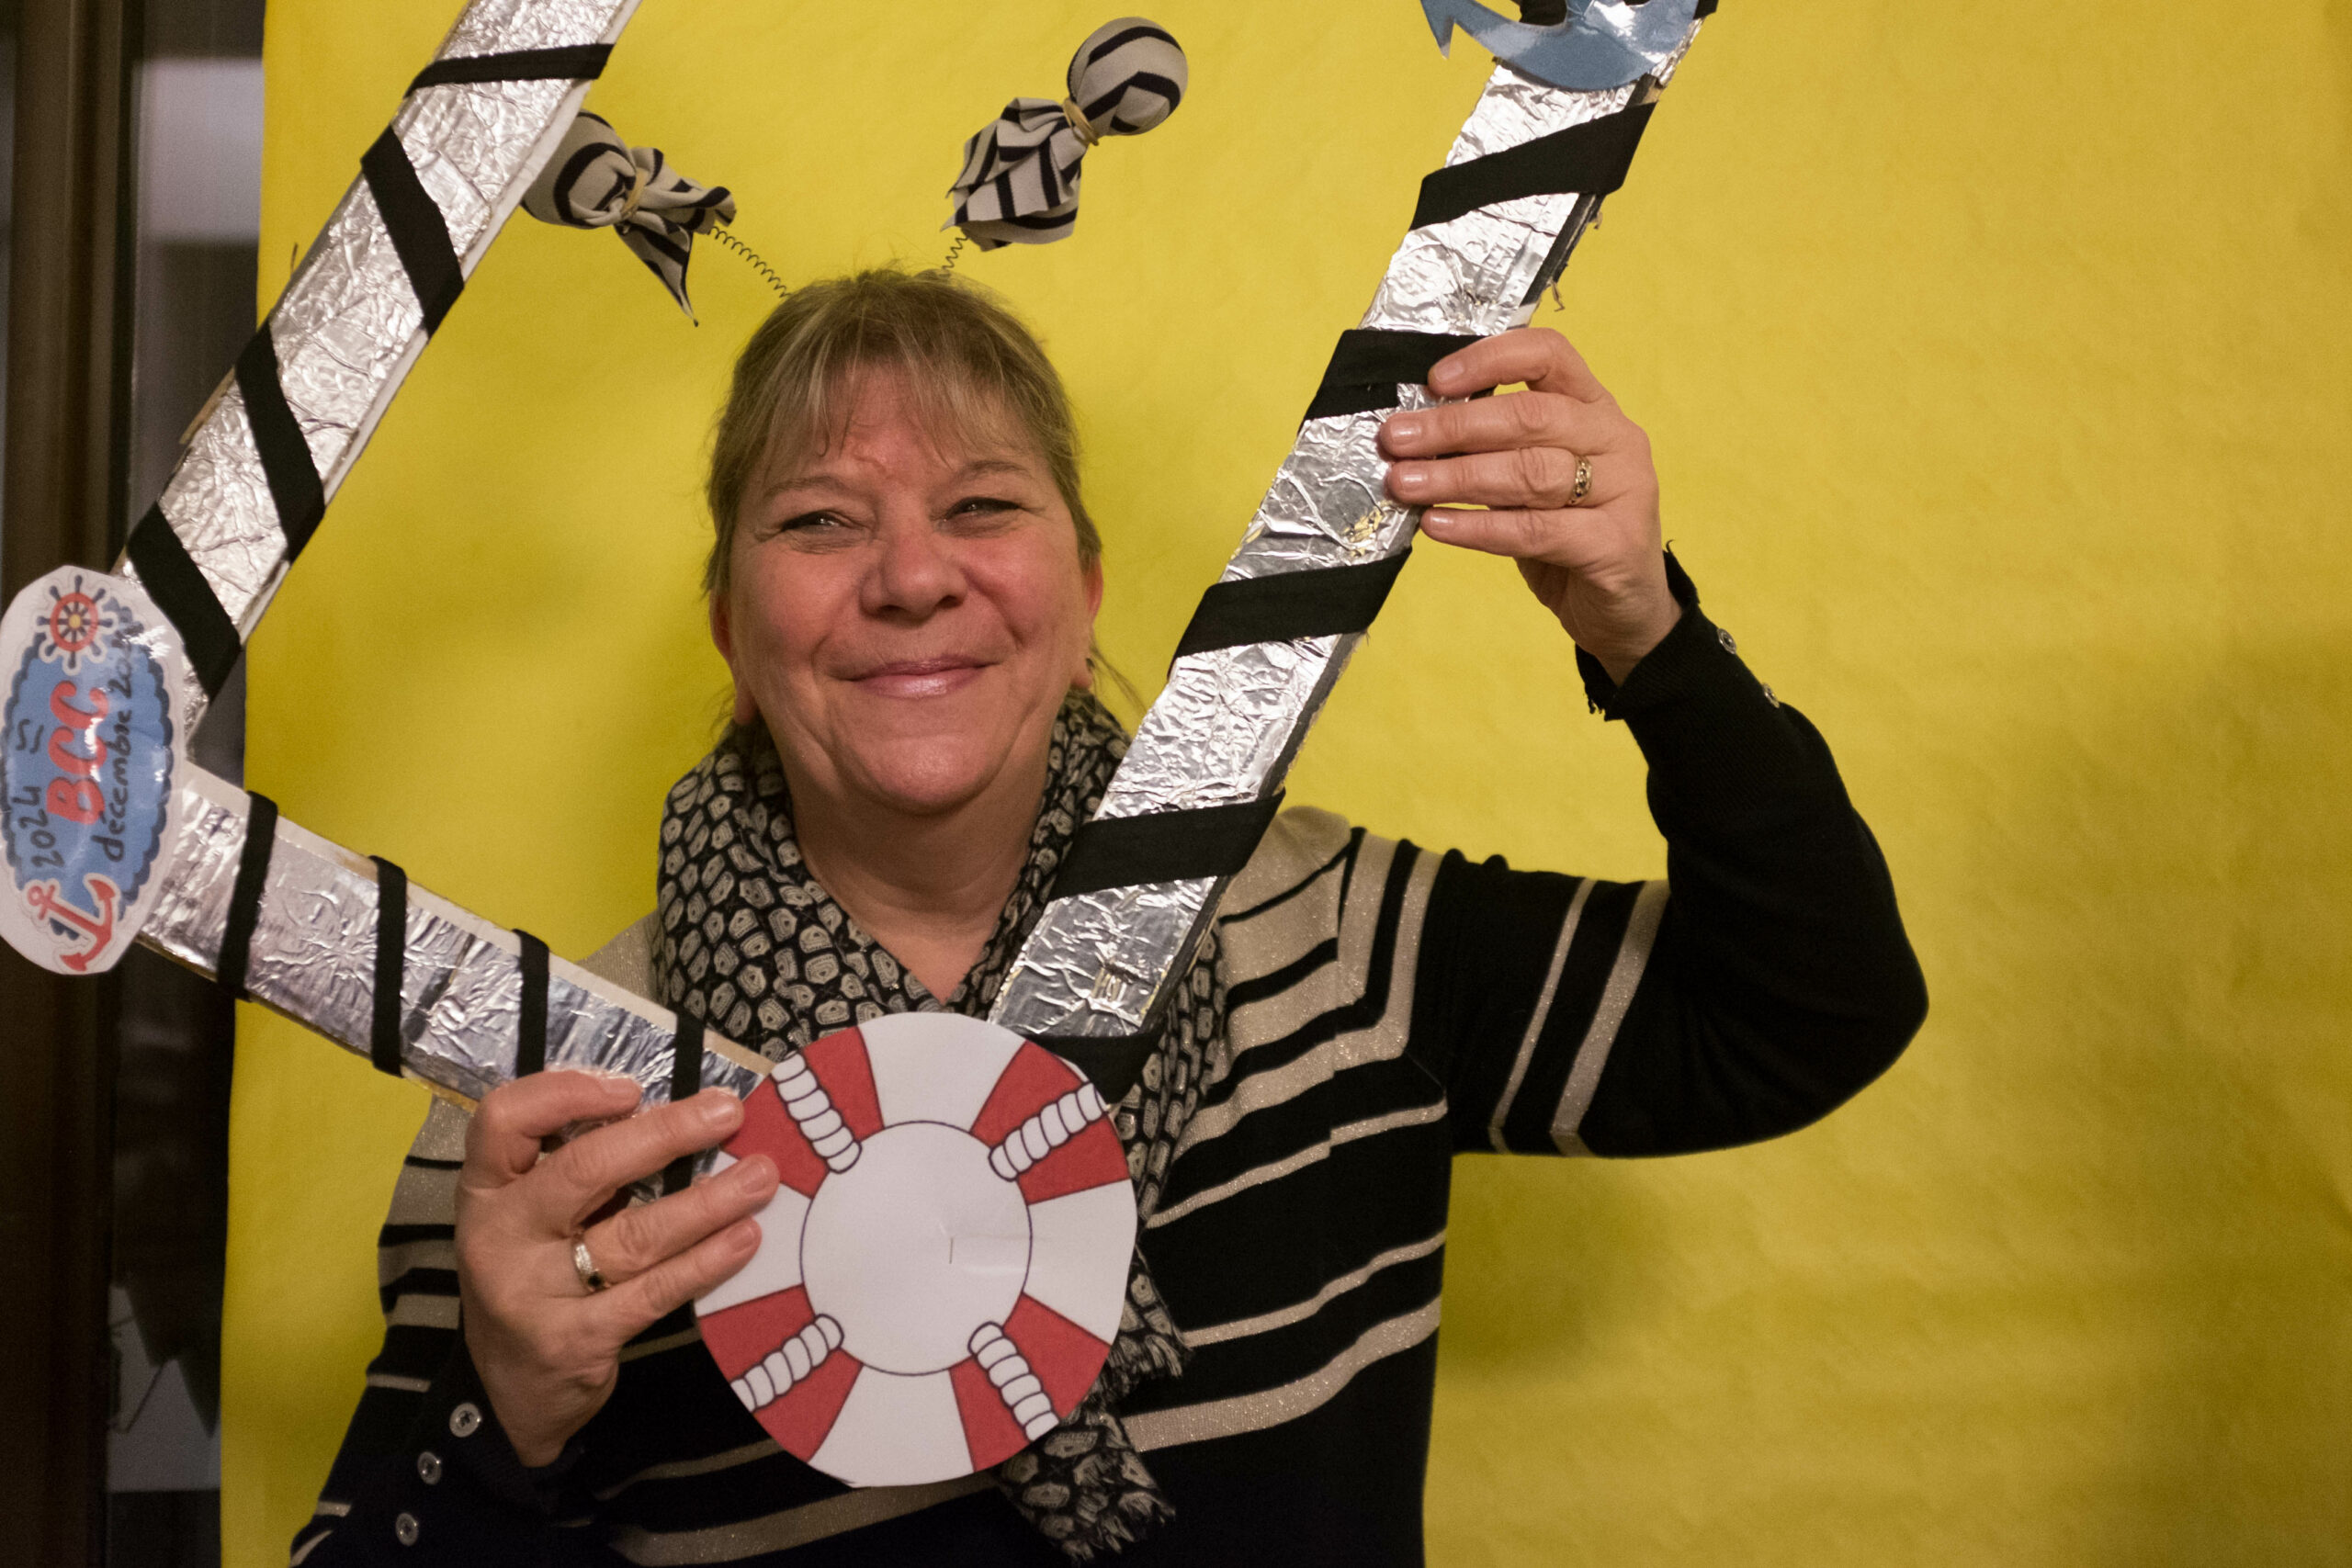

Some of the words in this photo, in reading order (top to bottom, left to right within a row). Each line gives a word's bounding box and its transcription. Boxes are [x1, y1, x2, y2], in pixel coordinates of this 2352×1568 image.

[47, 680, 109, 825] BCC
[90, 709, 132, 863] décembre
[11, 785, 65, 868] 2024
